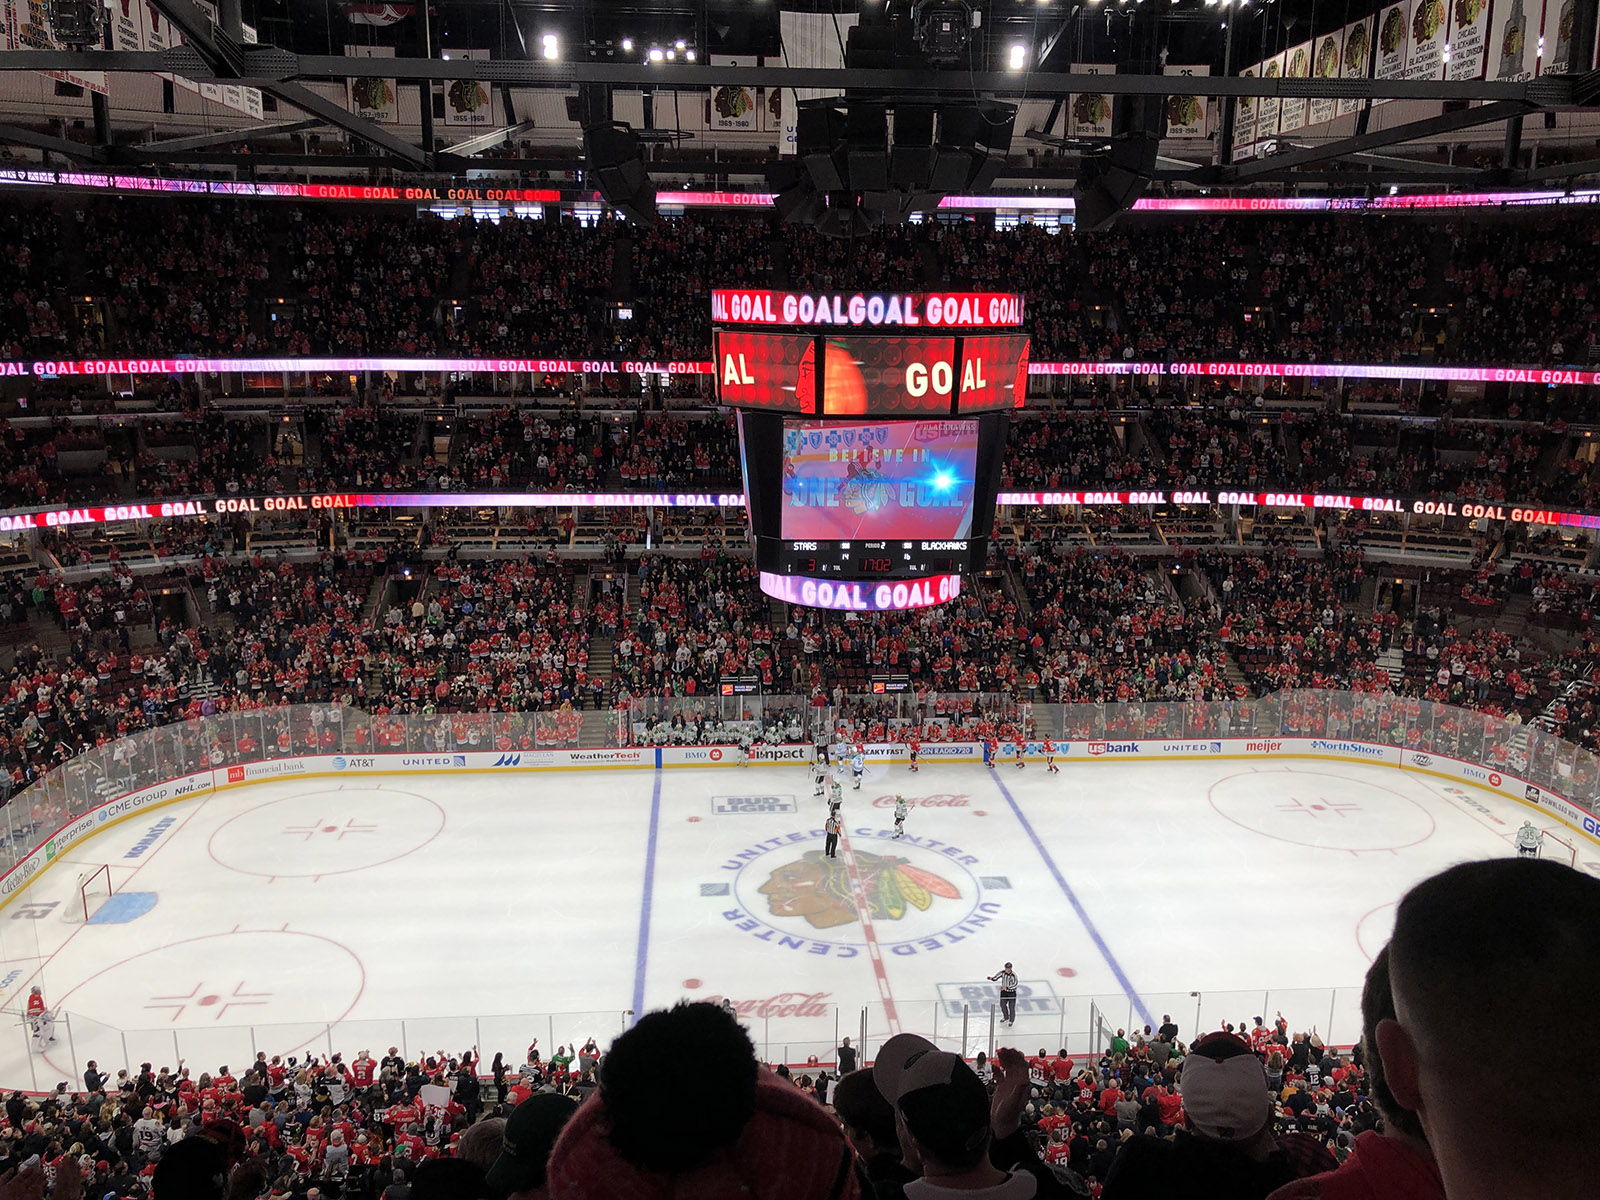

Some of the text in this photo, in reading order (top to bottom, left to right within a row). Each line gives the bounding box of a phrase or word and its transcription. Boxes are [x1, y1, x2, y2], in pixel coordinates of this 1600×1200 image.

[1457, 26, 1478, 40] CHICAGO
[1415, 41, 1437, 54] CHICAGO
[1451, 35, 1481, 51] BLACKHAWKS
[1466, 45, 1484, 57] DIVISION
[1450, 58, 1477, 72] CHAMPIONS
[1543, 62, 1569, 76] STANLE
[1517, 72, 1531, 81] CUP
[363, 187, 399, 198] GOAL
[406, 188, 440, 199] GOAL
[448, 189, 482, 200] GOAL
[486, 189, 521, 200] GOAL
[731, 294, 777, 322] GOAL
[926, 296, 984, 325] GOAL
[989, 296, 1020, 324] GOAL
[33, 361, 80, 375] GOAL
[174, 360, 216, 372] GOAL
[499, 360, 535, 372] GOAL
[539, 361, 575, 372] GOAL
[582, 361, 619, 373] GOAL
[625, 361, 661, 374] GOAL
[668, 362, 703, 374] GOAL
[723, 353, 755, 386] AL
[962, 357, 987, 392] AL
[1133, 363, 1167, 374] GOAL
[1170, 363, 1205, 375] GOAL
[1284, 364, 1321, 377] GOAL
[1495, 370, 1536, 382] GOAL
[1541, 370, 1584, 384] GOAL
[905, 360, 953, 397] GO
[829, 449, 932, 463] BELIEVE IN
[793, 477, 964, 507] ONE GOAL
[46, 509, 95, 526] GOAL
[104, 505, 152, 521] GOAL
[161, 501, 207, 517] GOAL
[215, 498, 260, 513] GOAL
[264, 496, 308, 511] GOAL
[311, 495, 354, 508] GOAL
[676, 494, 715, 506] GOAL
[719, 494, 745, 506] GOA
[1002, 492, 1557, 525] GOAL GOAL GOAL GOAL GOAL GOAL GOAL GOAL GOAL GOAL GOAL GOAL
[793, 541, 817, 551] STARS
[880, 541, 886, 550] 2
[921, 541, 968, 550] BLACKHAWKS
[808, 558, 816, 572] 3
[864, 558, 892, 572] 17:02
[802, 579, 867, 609] GOAL
[875, 579, 935, 609] GOAL
[757, 747, 805, 761] impact
[1163, 744, 1207, 752] UNITED
[1246, 740, 1283, 754] meijer
[402, 757, 450, 766] UNITED
[570, 751, 640, 760] WeatherTech
[229, 760, 305, 779] mb financial bank
[349, 758, 375, 768] AT&T
[1463, 768, 1486, 780] BMO
[174, 781, 211, 796] NHL.COM
[108, 788, 168, 817] CME Group
[717, 803, 792, 813] LIGHT
[727, 797, 780, 805] BUD
[872, 794, 971, 808] Coa-Cola
[1541, 795, 1567, 815] DOWNLOAD
[46, 818, 93, 858] enterprise
[123, 816, 178, 859] KOMATSU
[1524, 831, 1534, 840] 35
[722, 828, 979, 871] UNITED CENTER
[5, 857, 40, 894] Techo-Bloc
[722, 908, 859, 959] CENTER
[892, 901, 1001, 957] UNITED
[1310, 1074, 1320, 1084] 12
[139, 1131, 152, 1141] 19
